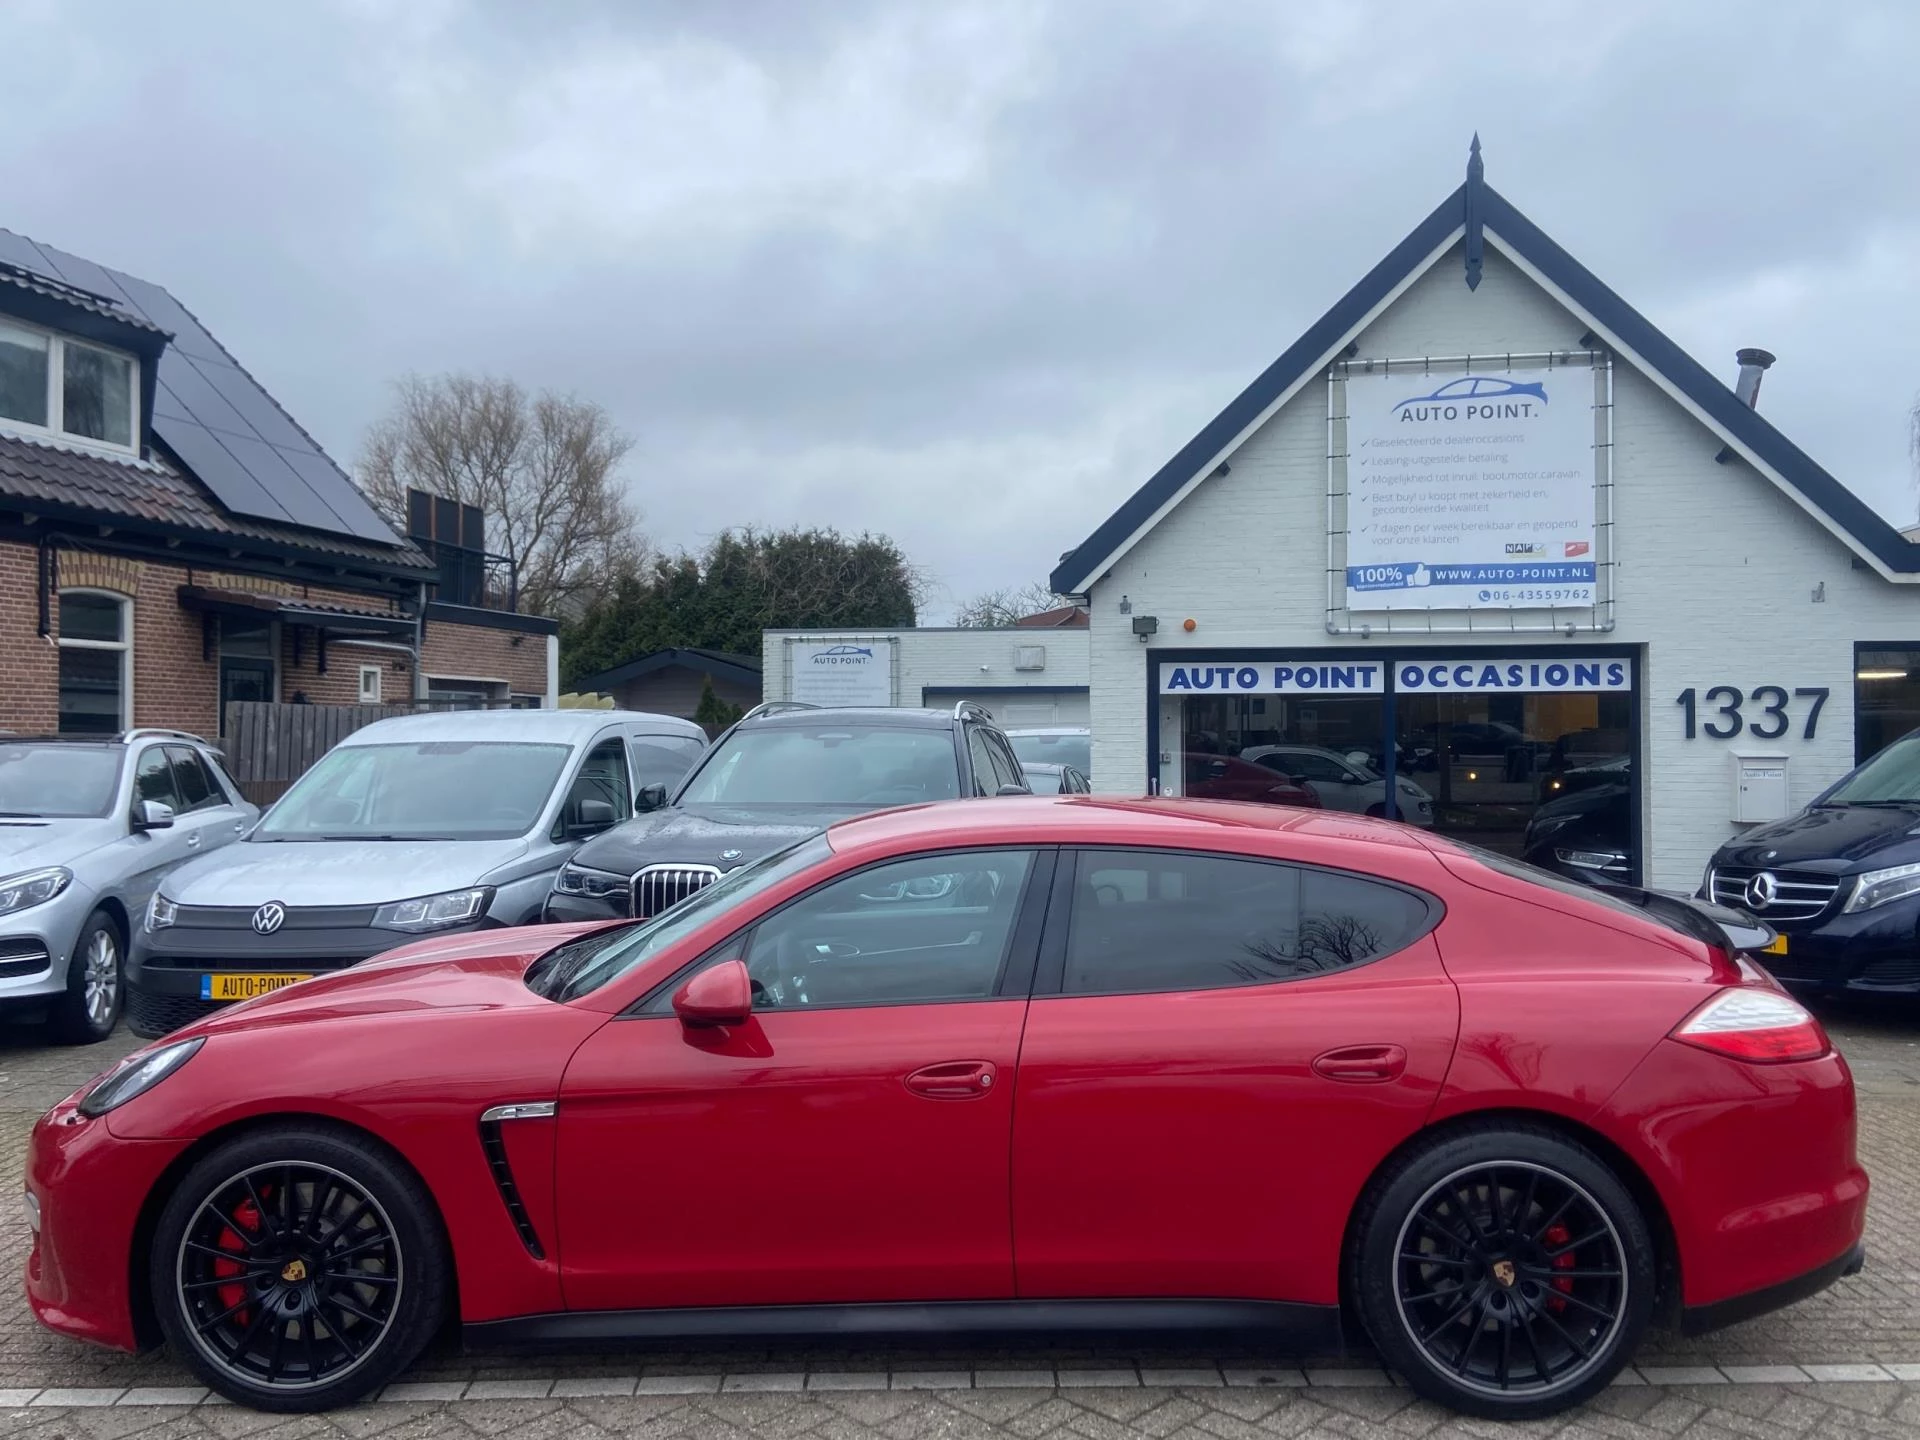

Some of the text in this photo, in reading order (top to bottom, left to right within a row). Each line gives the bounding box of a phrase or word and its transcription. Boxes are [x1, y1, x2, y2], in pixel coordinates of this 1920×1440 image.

[1400, 403, 1539, 422] AUTO POINT.
[1371, 433, 1525, 448] Geselecteerde dealeroccasions
[1468, 452, 1509, 465] betaling
[1371, 473, 1433, 486] Mogelijkheid
[1435, 473, 1449, 483] tot
[1372, 493, 1393, 503] Best
[1428, 491, 1457, 504] koopt
[1459, 492, 1480, 501] met
[1482, 489, 1531, 500] zekerheid
[1371, 503, 1490, 517] gecontroleerde kwaliteit
[1372, 519, 1579, 536] 7 dagen per week bereikbaar en geopend
[1371, 534, 1460, 546] voor onze klanten
[1356, 567, 1403, 583] 100%
[1436, 567, 1590, 580] WWW.AUTO-POINT.NL
[1493, 589, 1590, 601] 06-43559762
[1167, 663, 1626, 690] AUTO POINT OCCASIONS
[1676, 685, 1830, 740] 1337
[222, 977, 297, 996] AUTO-POI
